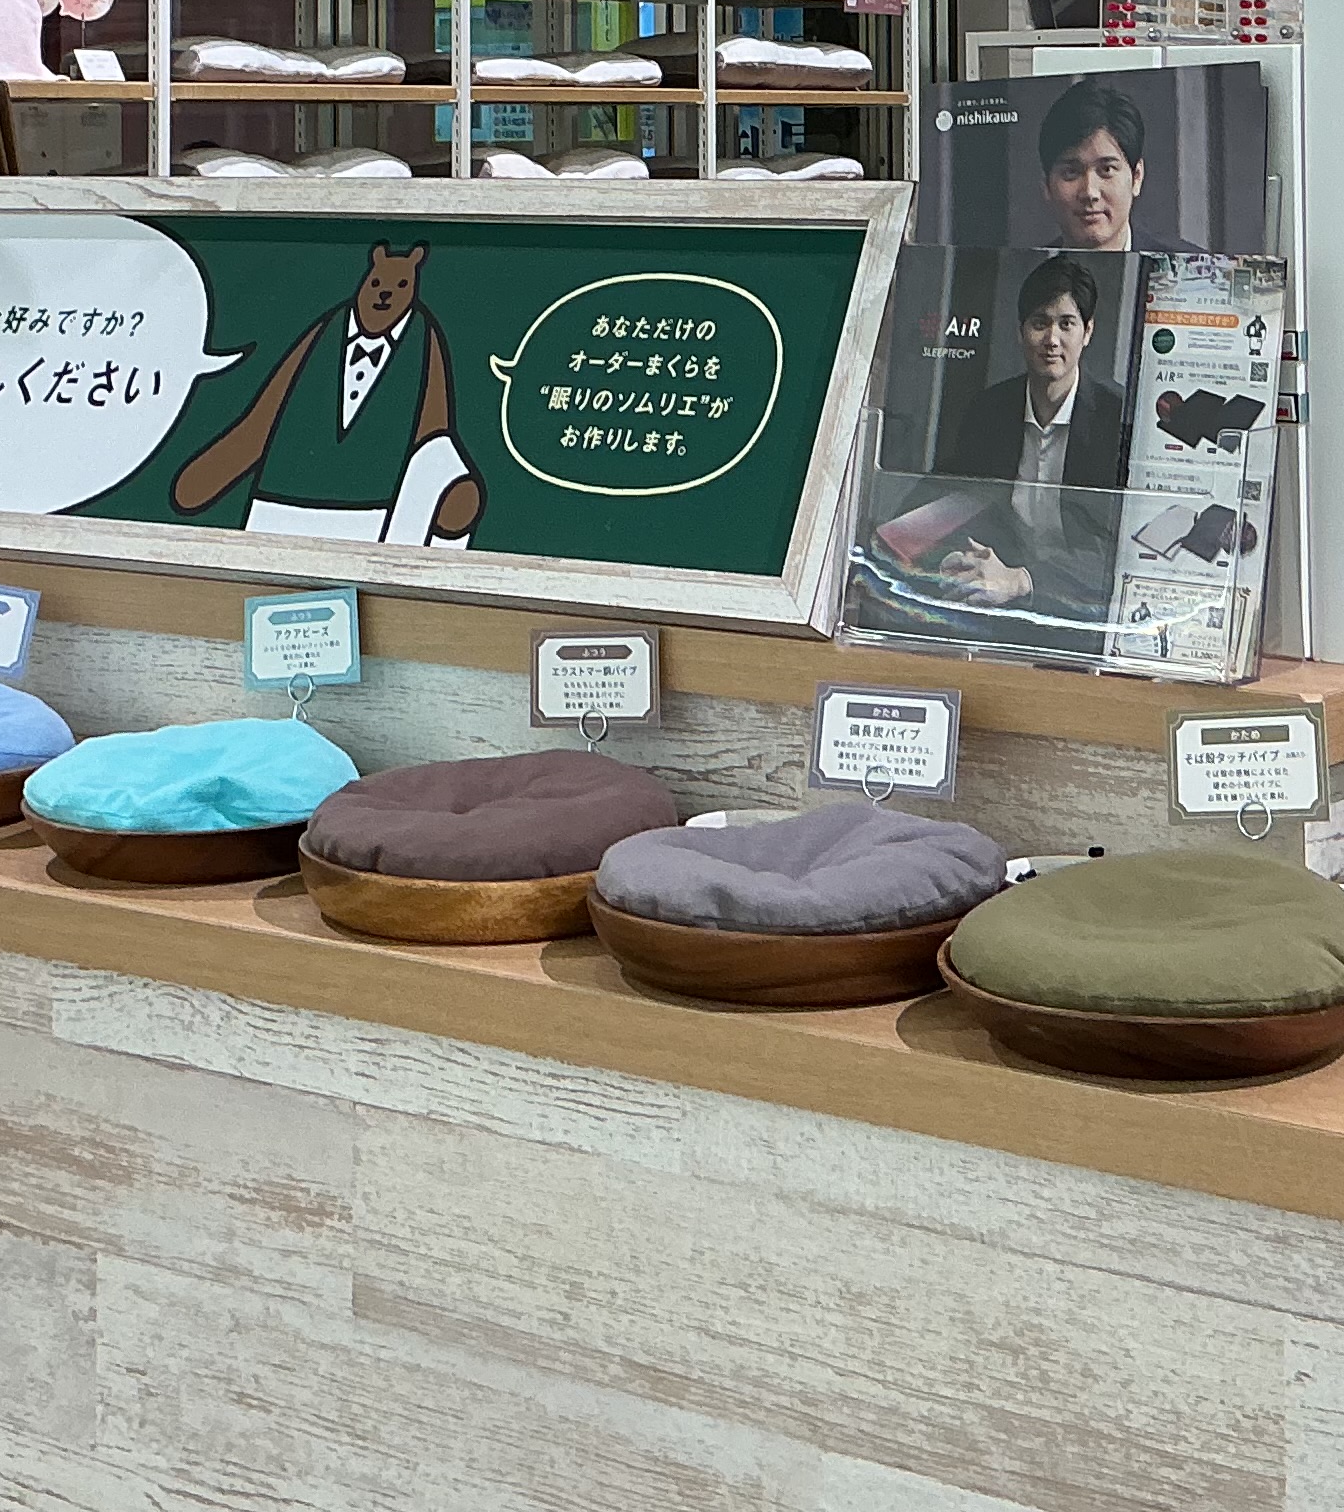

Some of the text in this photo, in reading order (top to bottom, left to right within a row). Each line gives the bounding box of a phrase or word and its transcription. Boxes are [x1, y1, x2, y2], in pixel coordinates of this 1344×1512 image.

[956, 109, 1019, 126] nishikawa
[591, 315, 716, 340] あなただけの
[568, 349, 721, 379] オーダーまくらを
[560, 425, 687, 456] お作りします。
[581, 647, 607, 658] ふつう
[872, 706, 902, 719] かため
[849, 723, 922, 741] 備長炭パイプ
[1230, 728, 1261, 741] かため
[1183, 749, 1280, 766] そば殻タッチパイプ
